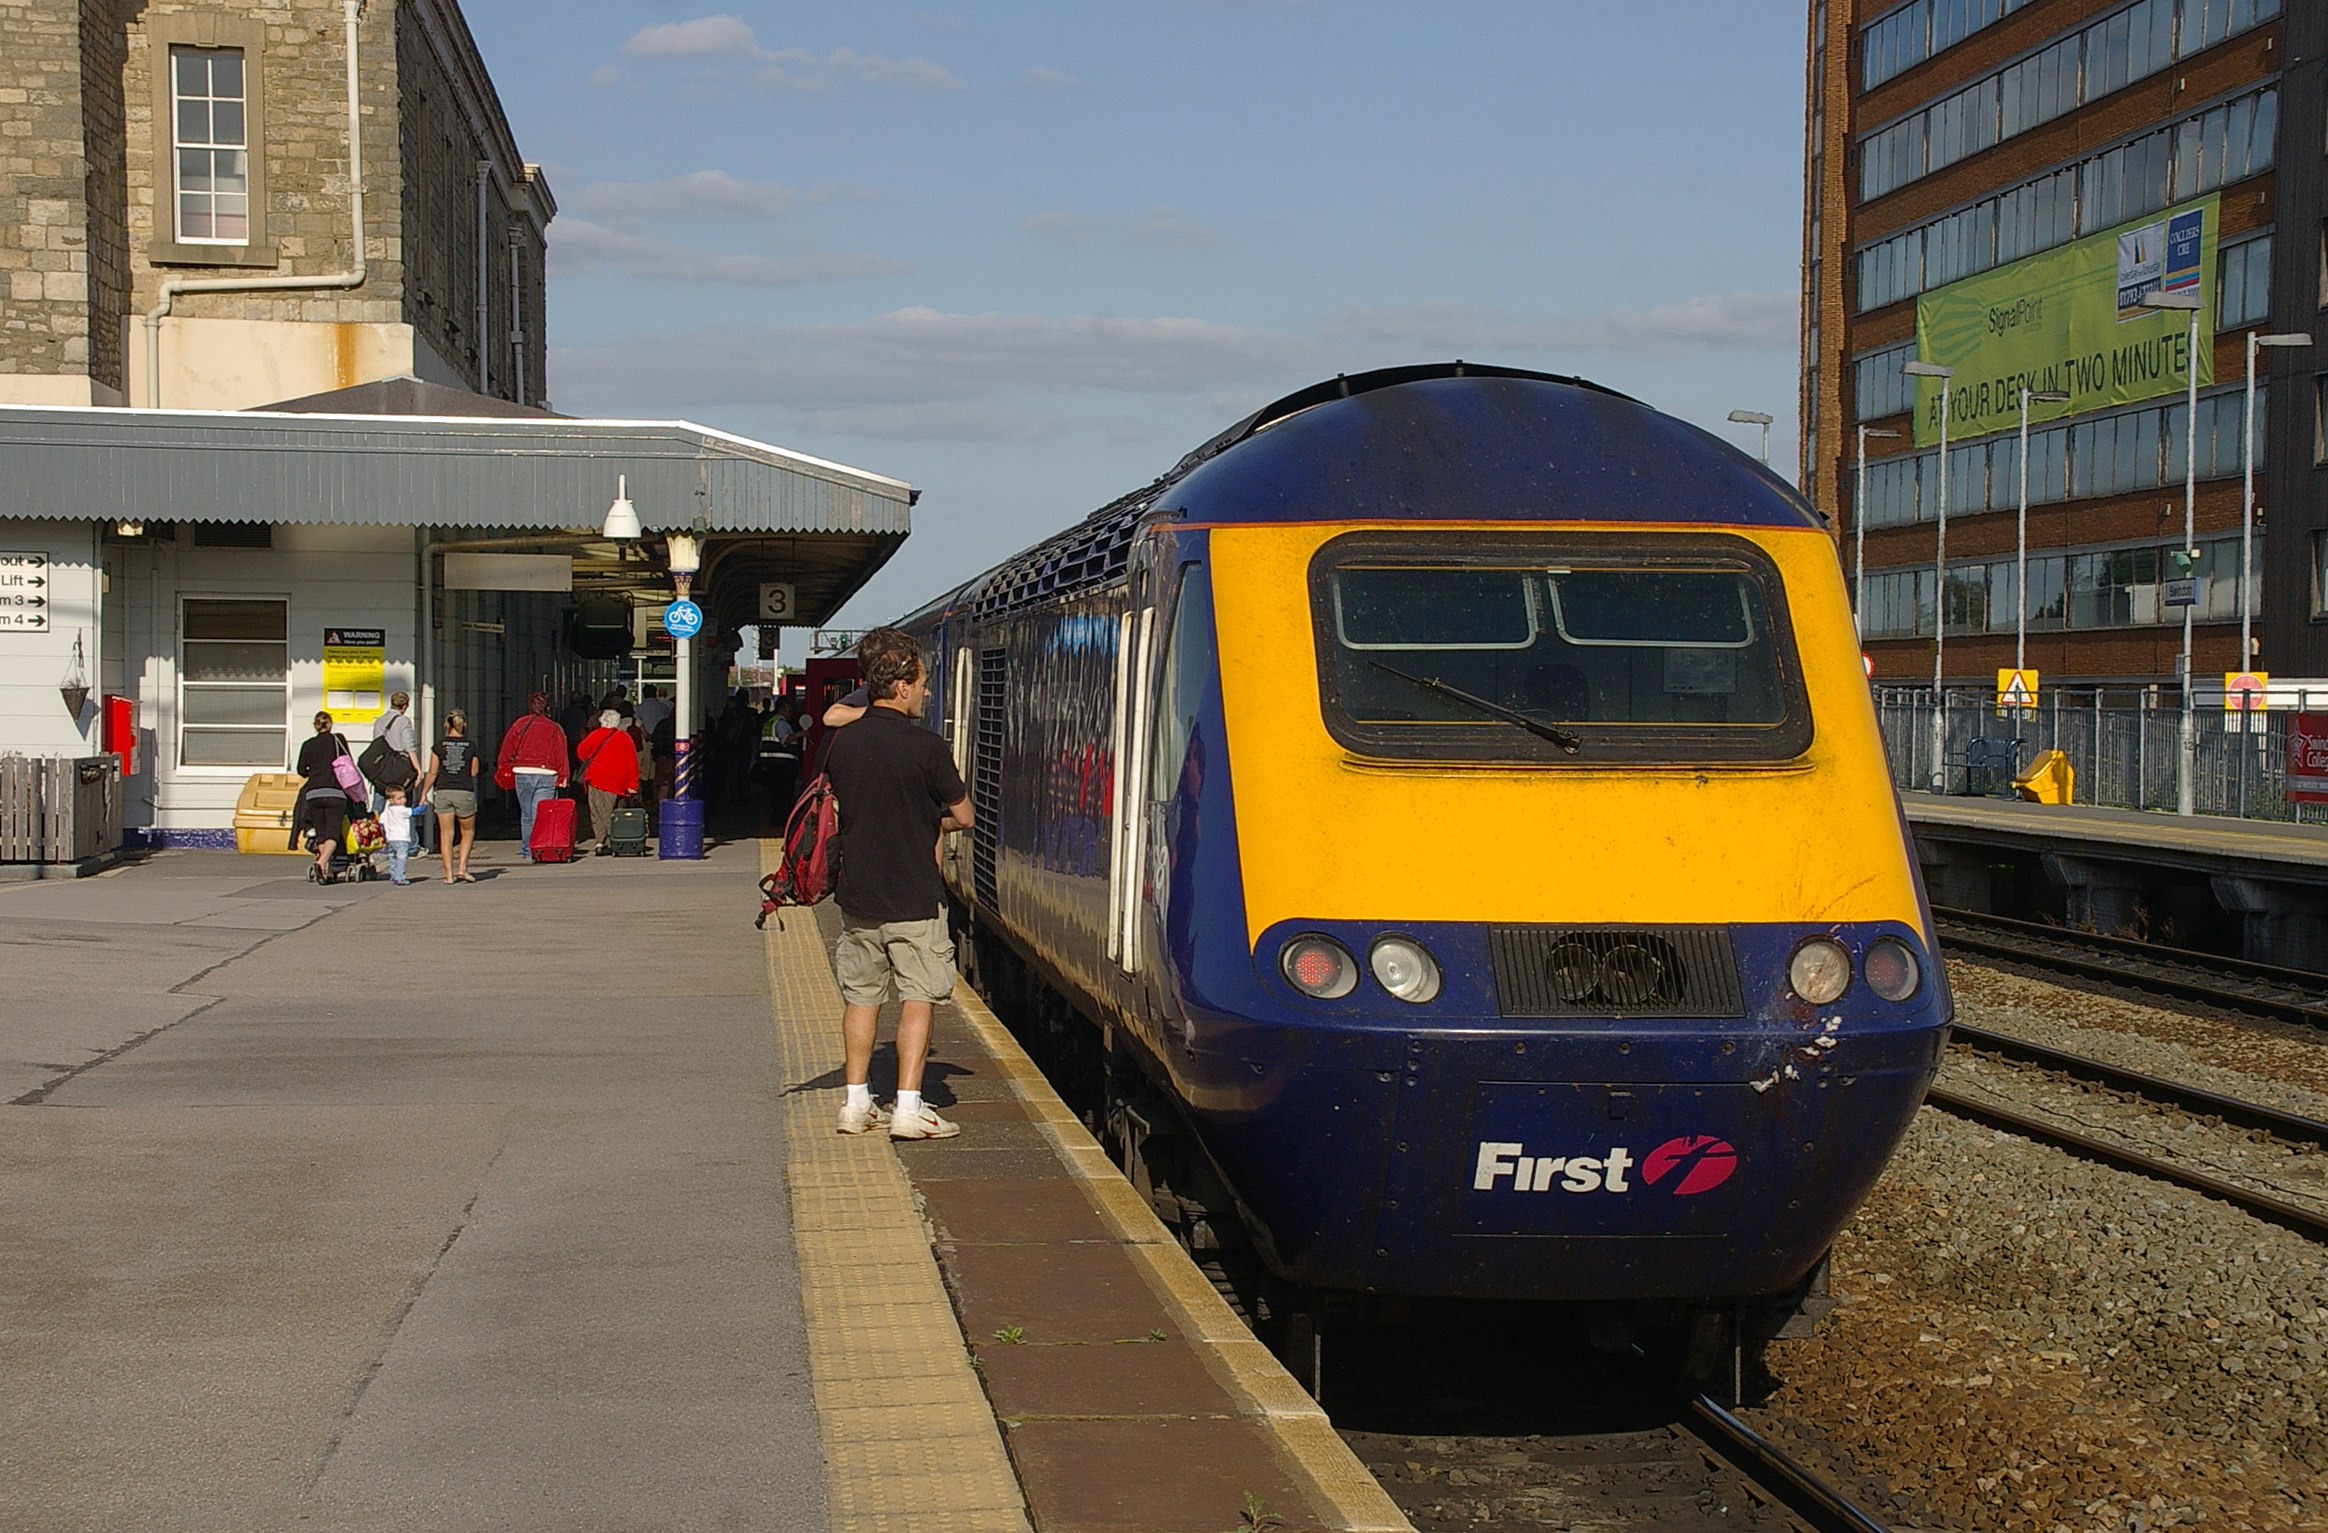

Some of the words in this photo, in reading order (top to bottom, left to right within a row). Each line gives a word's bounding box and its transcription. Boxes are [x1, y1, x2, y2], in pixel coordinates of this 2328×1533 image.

[2169, 225, 2200, 245] COLLIERS
[2177, 242, 2191, 256] CRE
[1988, 297, 2042, 337] SignalPoint
[1949, 381, 1990, 422] YOUR
[1995, 369, 2038, 415] DESK
[2043, 363, 2059, 394] IN
[2065, 352, 2105, 396] TWO
[1, 574, 24, 586] Lift
[14, 594, 24, 606] 3
[767, 589, 787, 614] 3
[14, 614, 24, 625] 4
[343, 631, 380, 640] WARNING
[2183, 740, 2194, 751] 12
[1473, 1141, 1633, 1193] First
